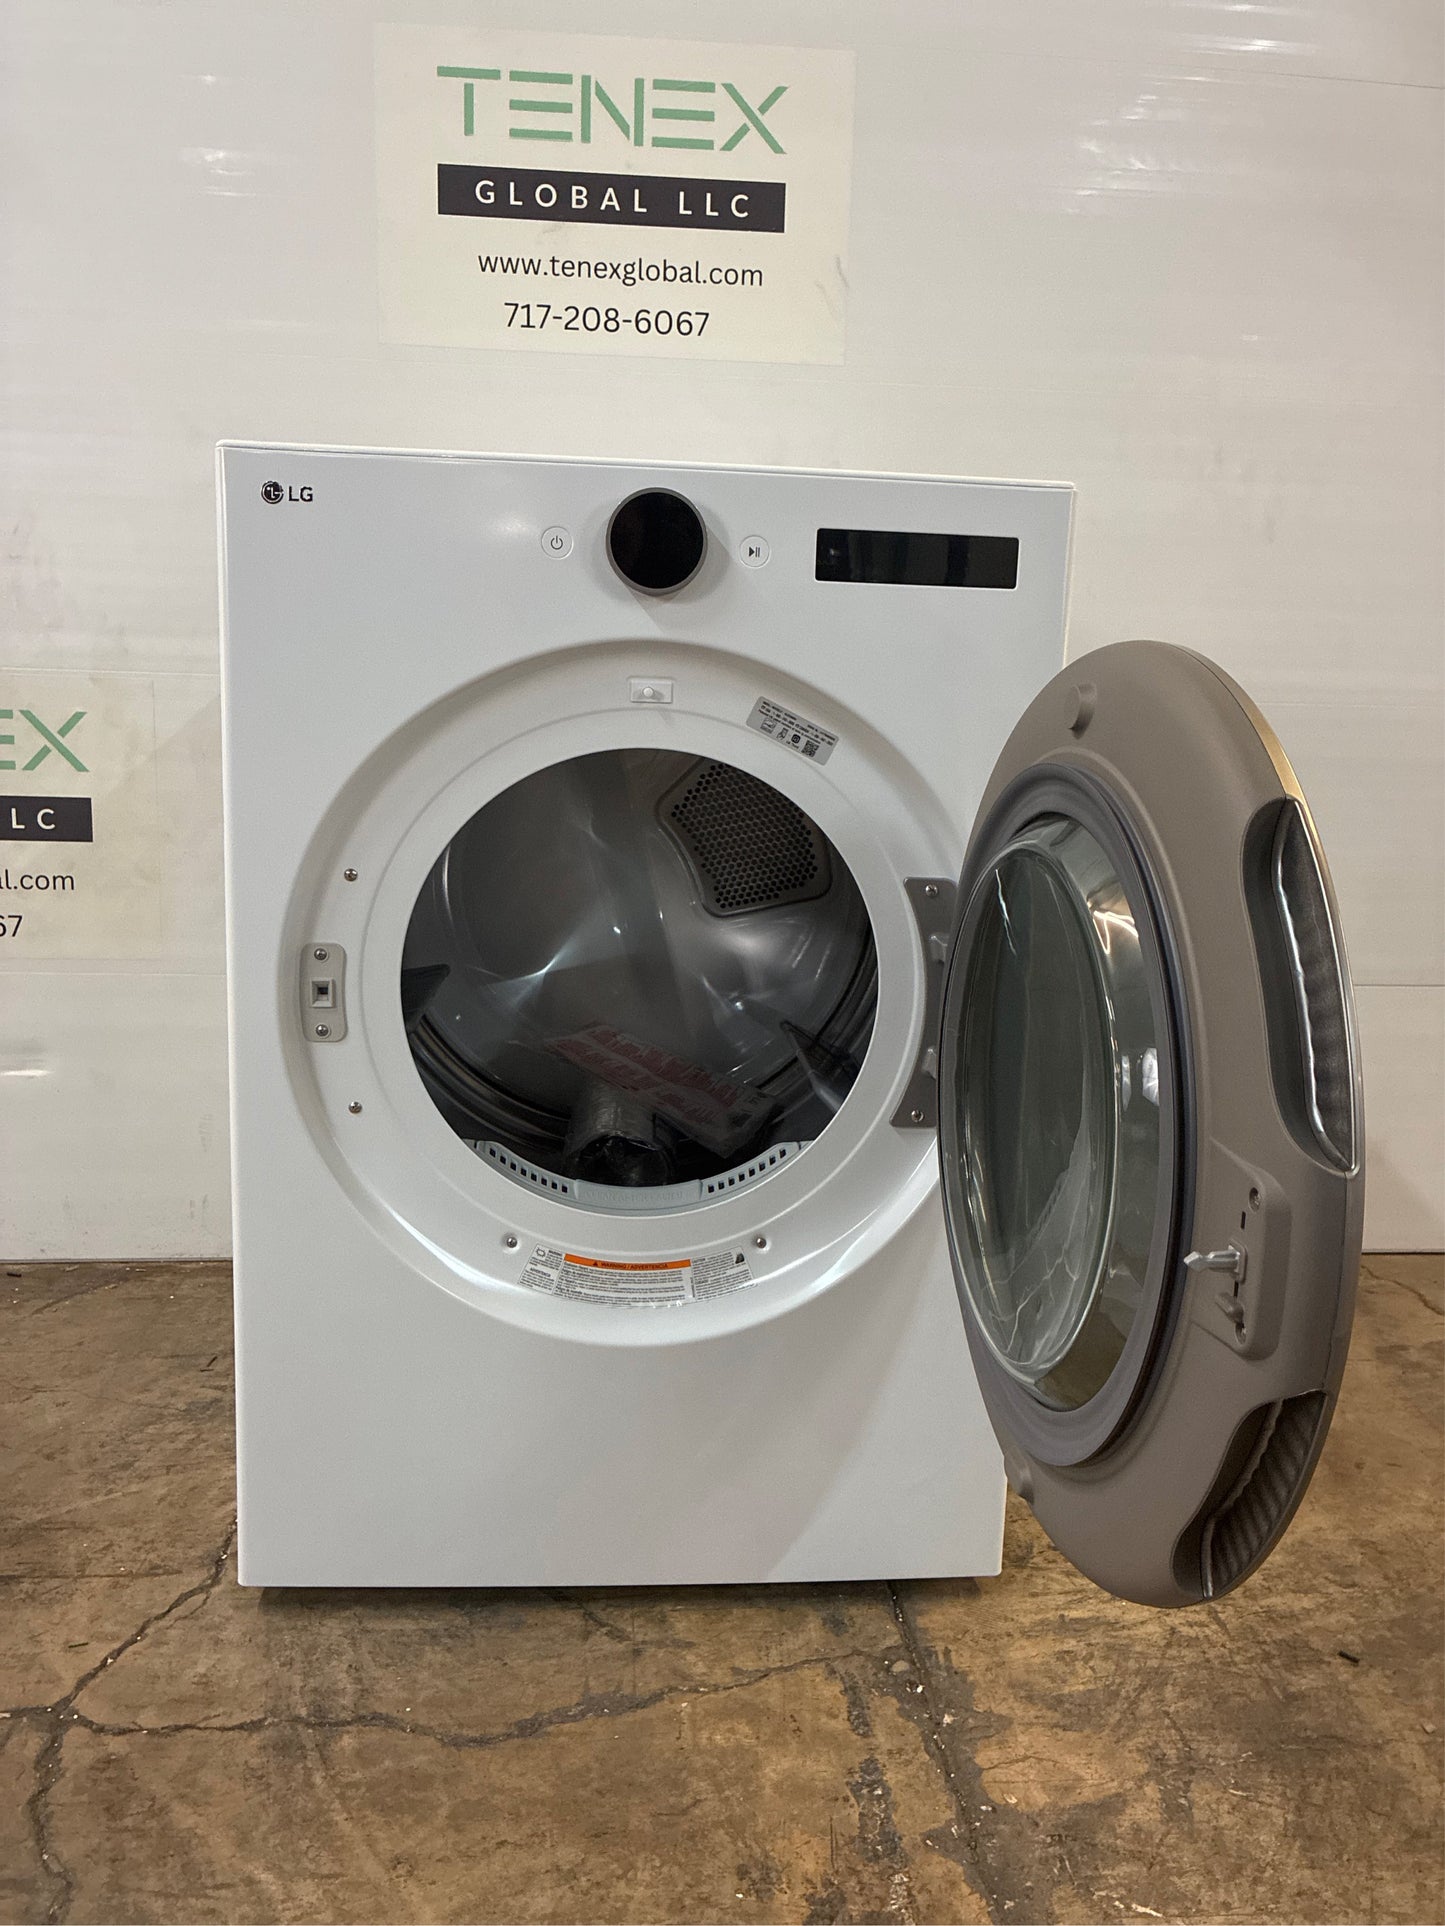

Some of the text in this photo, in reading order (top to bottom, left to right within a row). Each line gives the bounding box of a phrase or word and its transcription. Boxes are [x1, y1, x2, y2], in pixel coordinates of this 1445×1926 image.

[437, 65, 789, 154] TENEX
[474, 179, 749, 218] GLOBAL LLC
[478, 253, 763, 287] www.tenexglobal.com
[504, 302, 710, 337] 717-208-6067
[288, 485, 314, 502] LG
[0, 709, 90, 772] X
[0, 868, 75, 891] l.com
